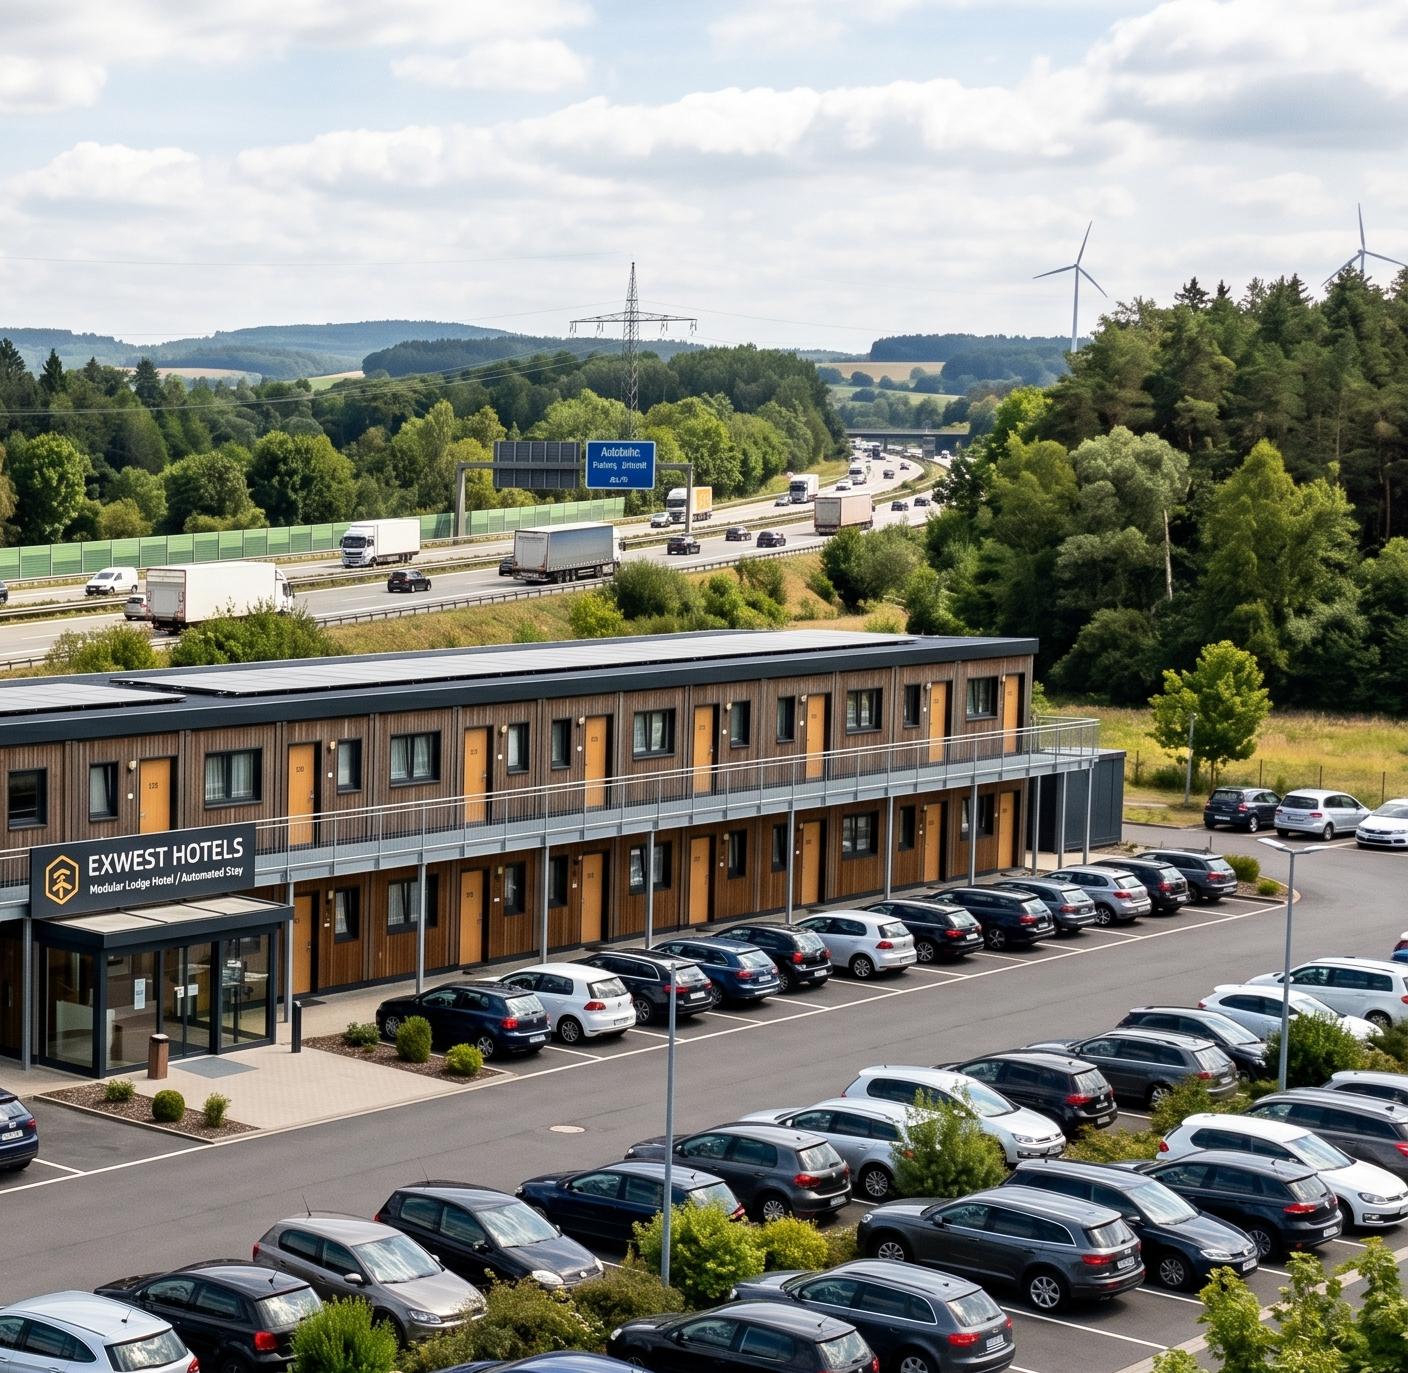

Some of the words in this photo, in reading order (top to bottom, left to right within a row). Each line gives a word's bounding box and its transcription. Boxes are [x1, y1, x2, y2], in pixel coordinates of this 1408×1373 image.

[88, 847, 169, 877] EXWEST
[173, 837, 244, 866] HOTELS
[89, 882, 125, 895] Modular
[125, 878, 151, 891] Lodge
[152, 874, 174, 886] Hotel
[181, 867, 224, 883] Automated
